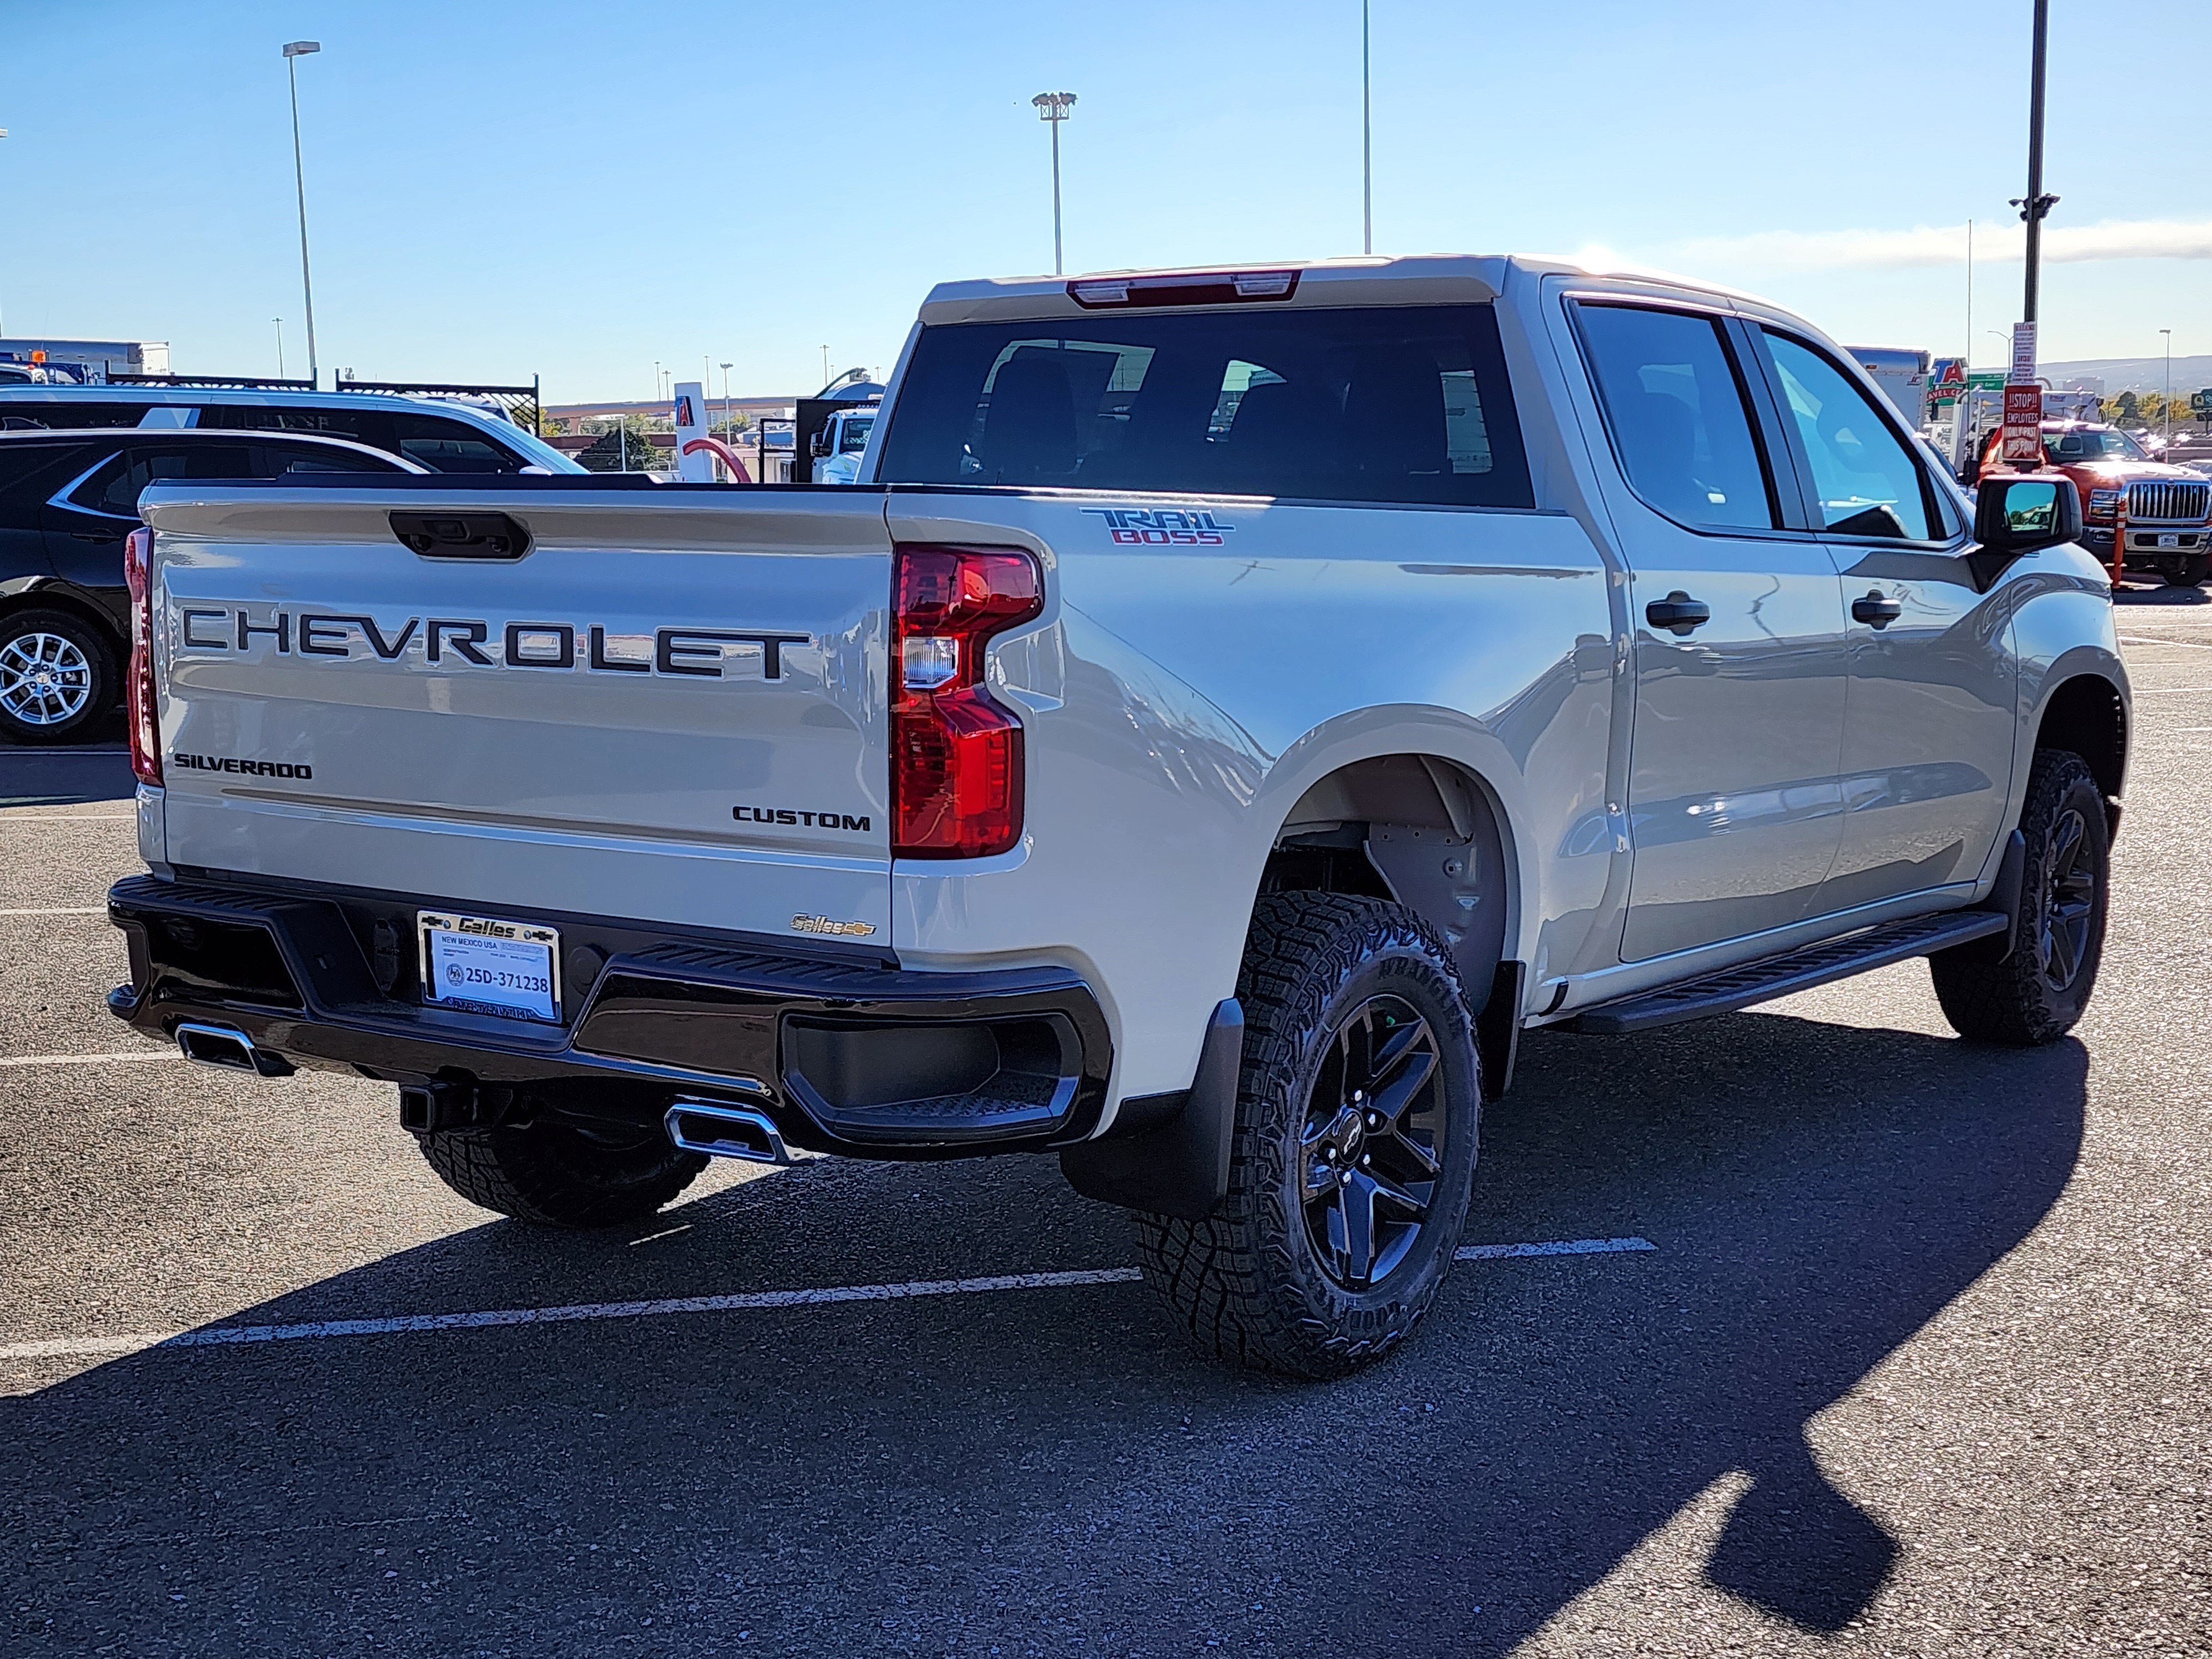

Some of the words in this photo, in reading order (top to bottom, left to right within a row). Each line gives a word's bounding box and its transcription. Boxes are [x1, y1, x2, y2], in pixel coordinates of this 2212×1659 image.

[1933, 359, 1968, 384] TA
[2007, 412, 2038, 424] EMPLOYEES
[2008, 426, 2022, 437] ONLY
[2023, 426, 2037, 437] PAST
[2007, 440, 2019, 451] THIS
[2020, 440, 2037, 452] POINT
[1079, 507, 1237, 532] TRAIL
[1109, 528, 1224, 546] BOSS
[180, 607, 812, 682] CHEVROLET
[174, 753, 312, 779] SILVERADO
[733, 806, 870, 832] CUSTOM
[458, 917, 516, 938] Galles
[458, 938, 483, 948] MEXICO
[466, 967, 549, 993] 25D-371238
